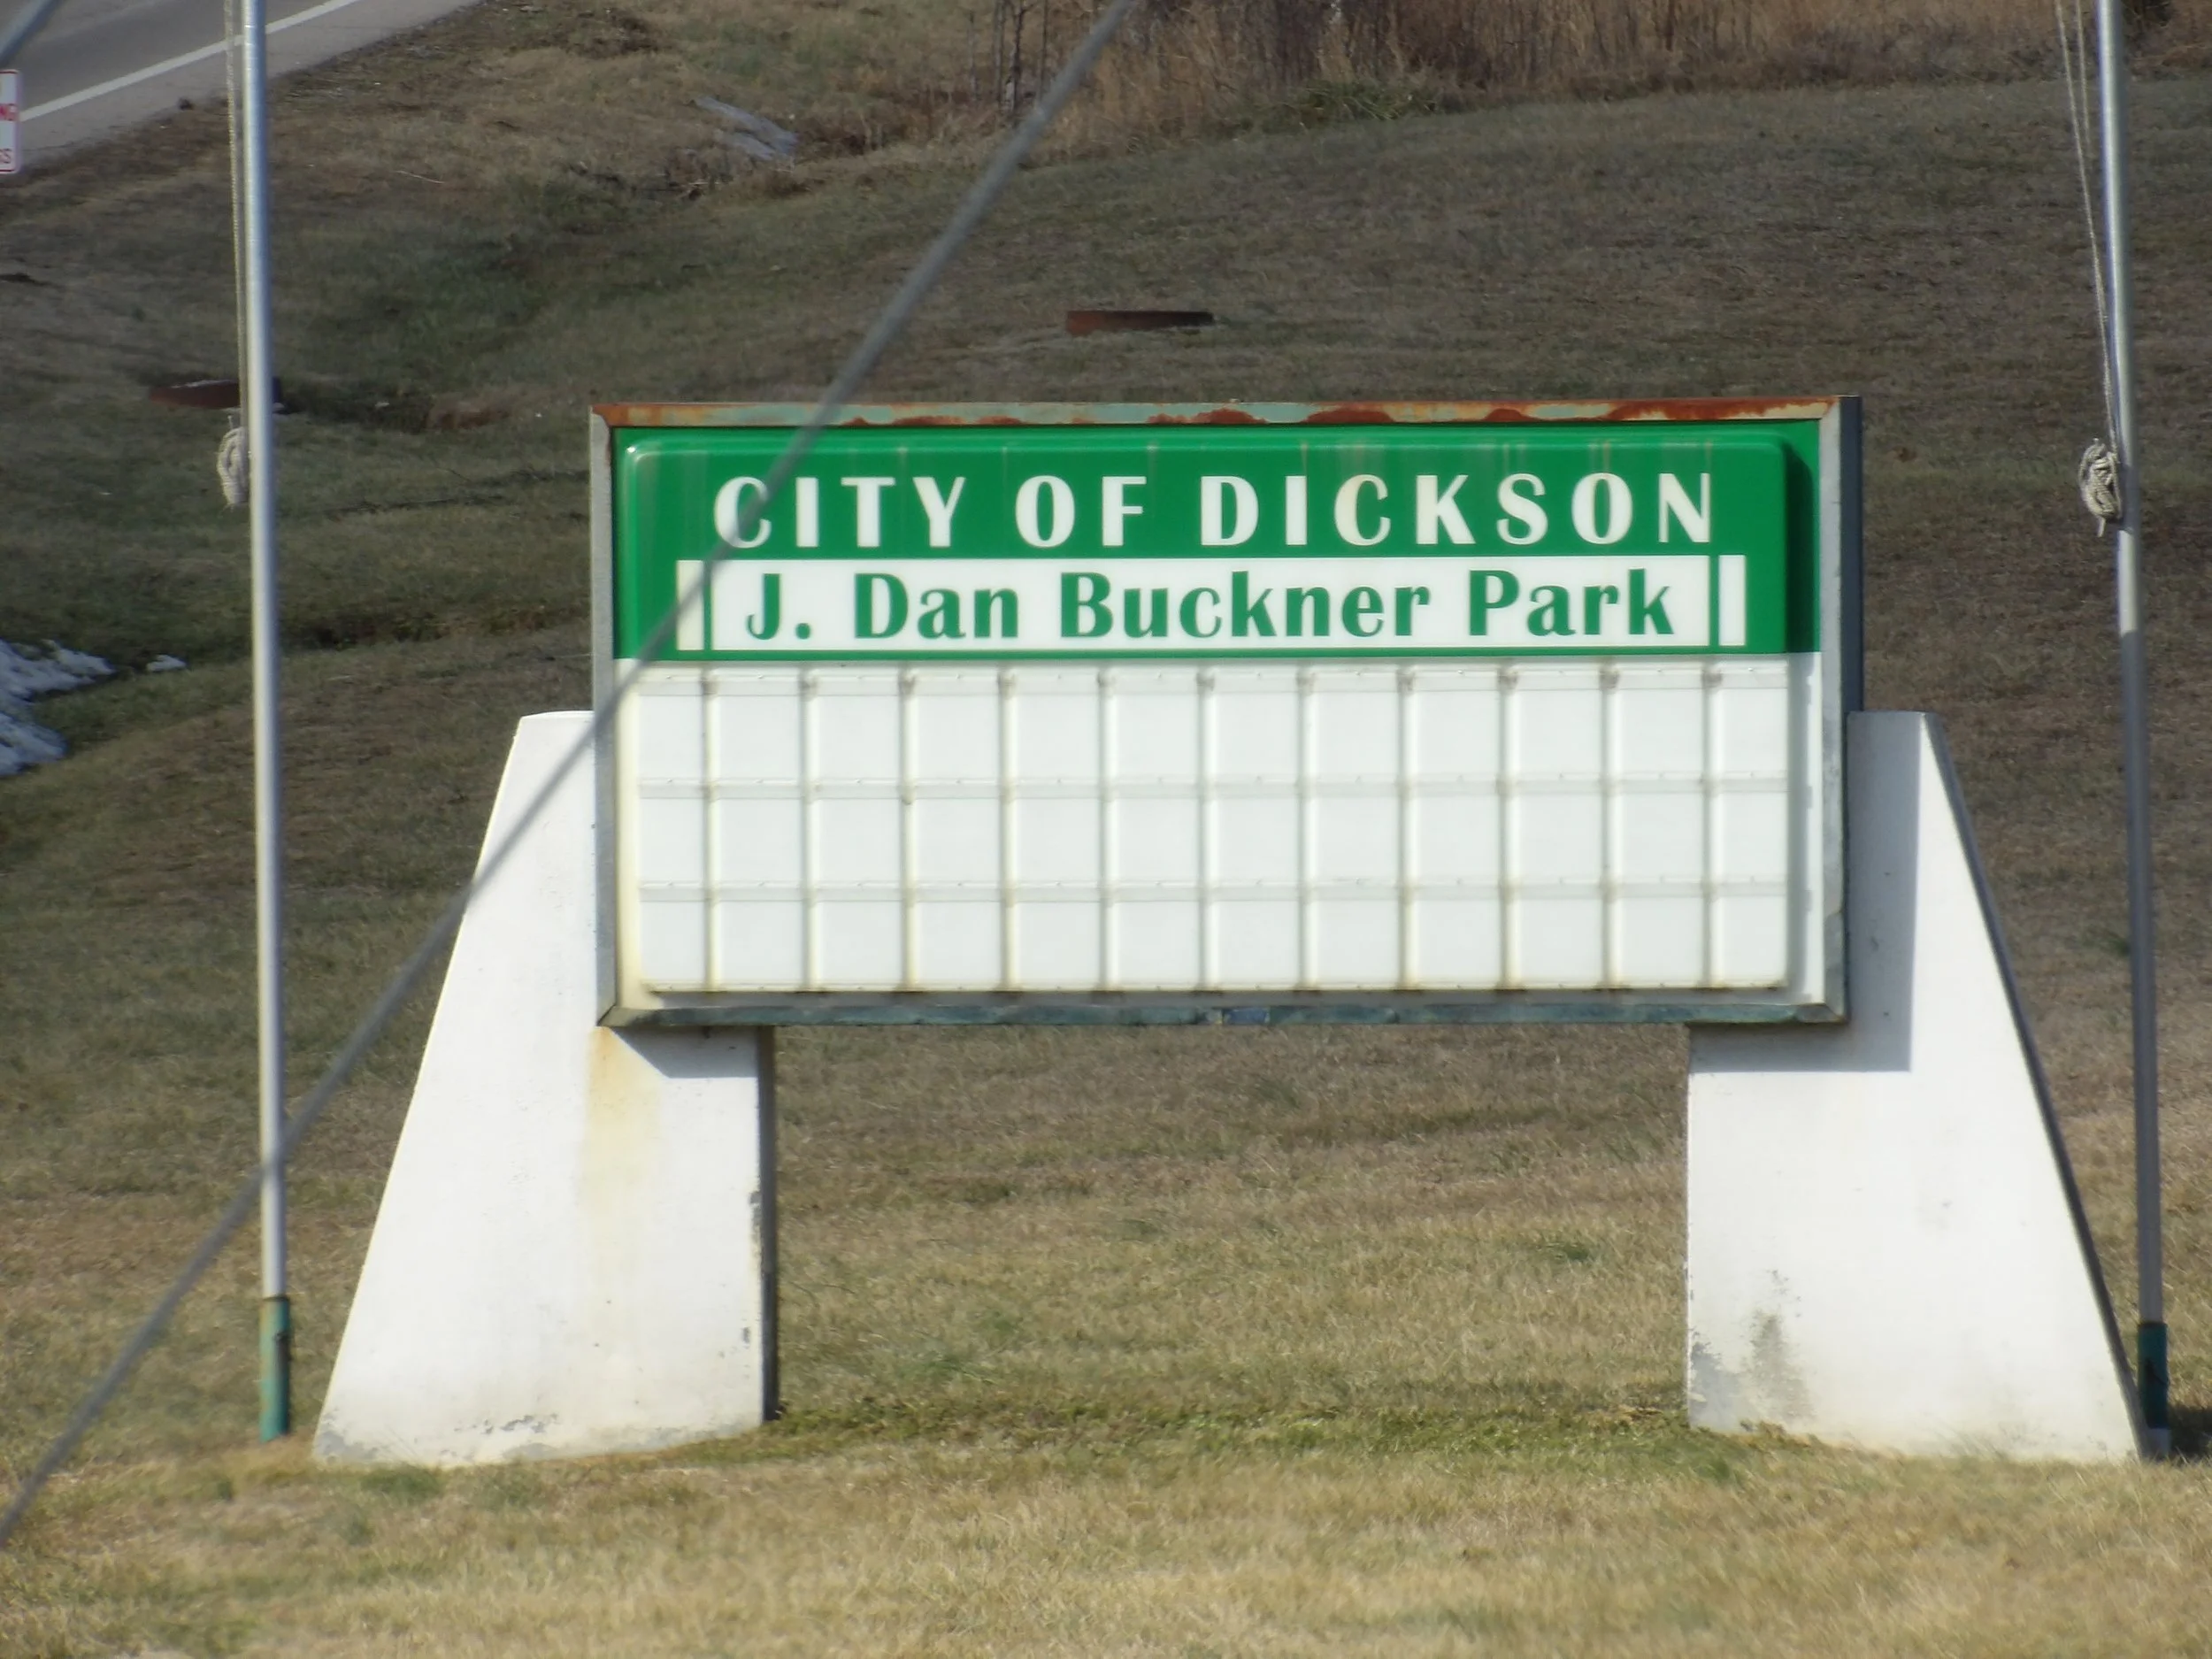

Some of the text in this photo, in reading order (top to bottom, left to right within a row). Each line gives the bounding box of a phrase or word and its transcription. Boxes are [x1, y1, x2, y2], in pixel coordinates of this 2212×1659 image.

[713, 472, 1711, 549] CITY OF DICKSON
[746, 567, 1674, 641] J. Dan Buckner Park
